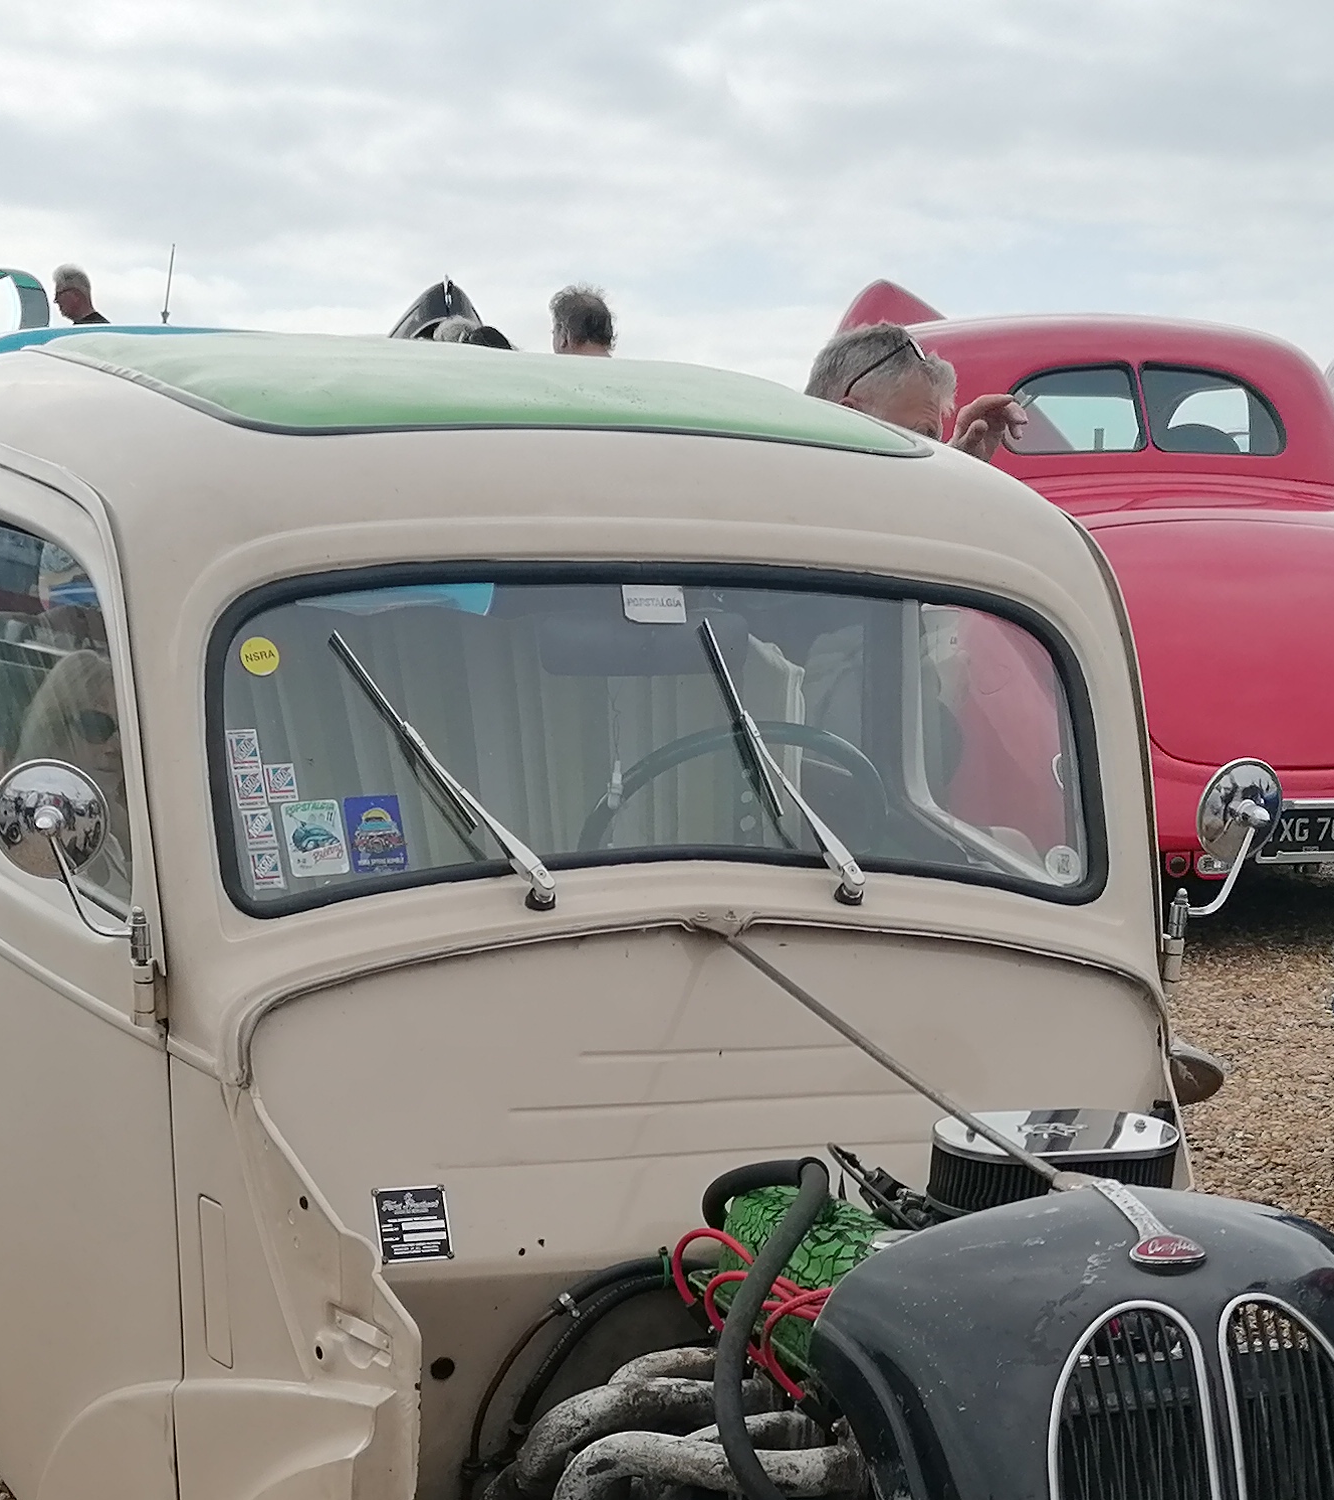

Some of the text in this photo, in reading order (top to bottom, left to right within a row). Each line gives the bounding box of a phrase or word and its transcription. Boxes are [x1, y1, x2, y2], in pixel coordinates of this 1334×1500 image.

[244, 650, 276, 664] NSRA
[249, 814, 269, 839] NSRA
[254, 854, 276, 879] NSRA
